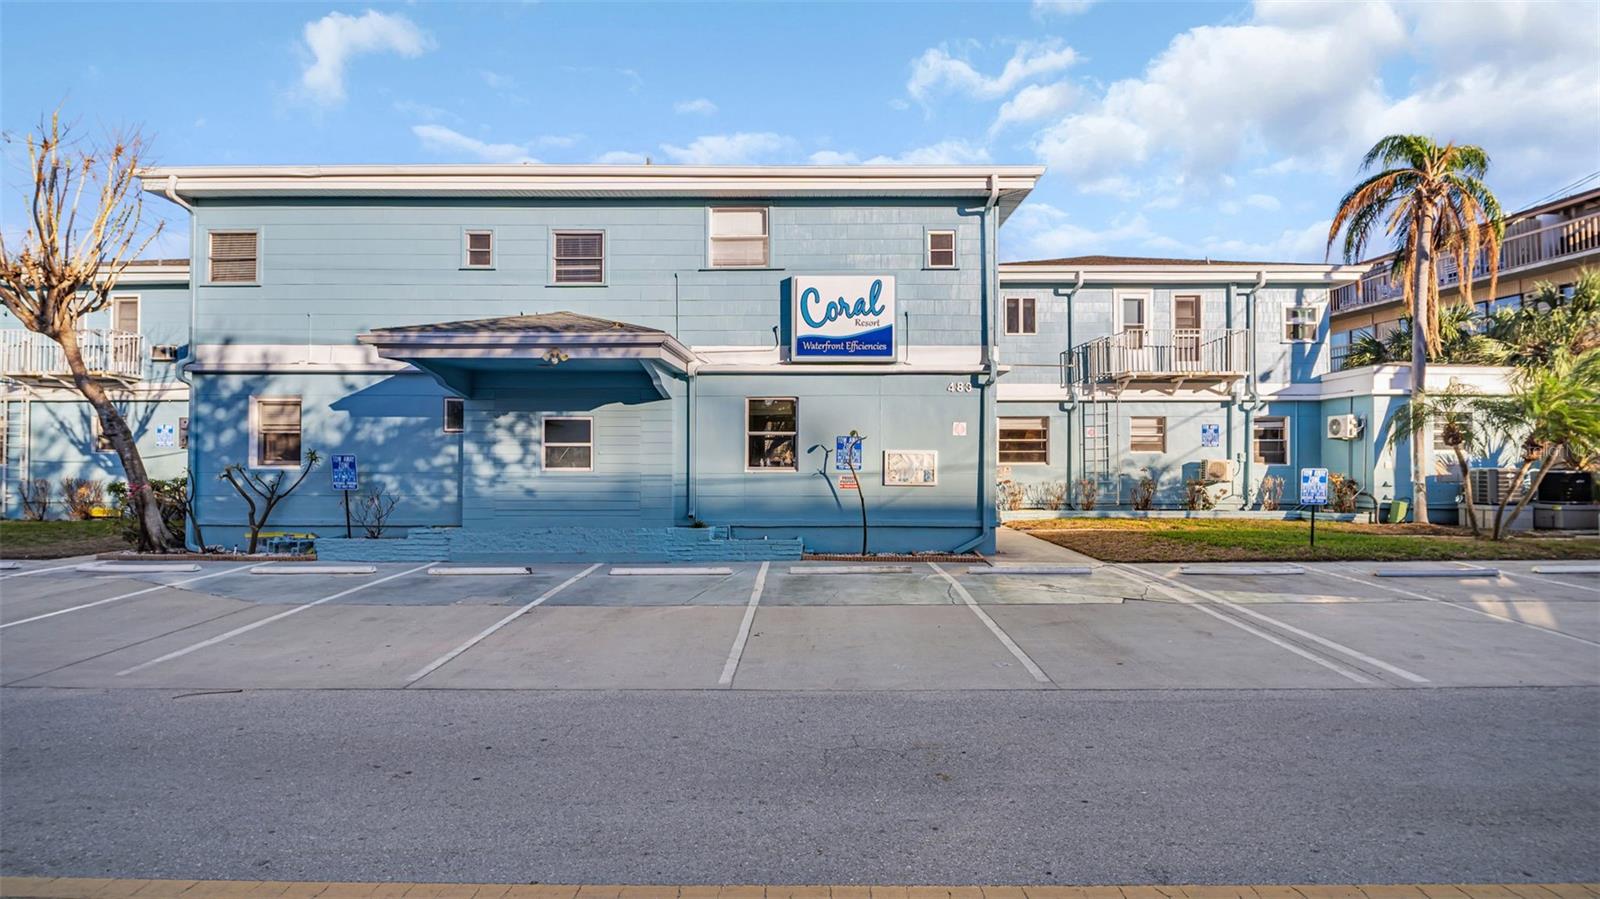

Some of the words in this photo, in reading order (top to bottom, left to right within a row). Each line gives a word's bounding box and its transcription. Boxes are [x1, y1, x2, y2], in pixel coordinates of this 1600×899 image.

[800, 279, 885, 328] Coral
[855, 319, 880, 327] Resort
[803, 341, 844, 352] Waterfront
[846, 340, 887, 353] Efficiencies
[947, 382, 972, 392] 483
